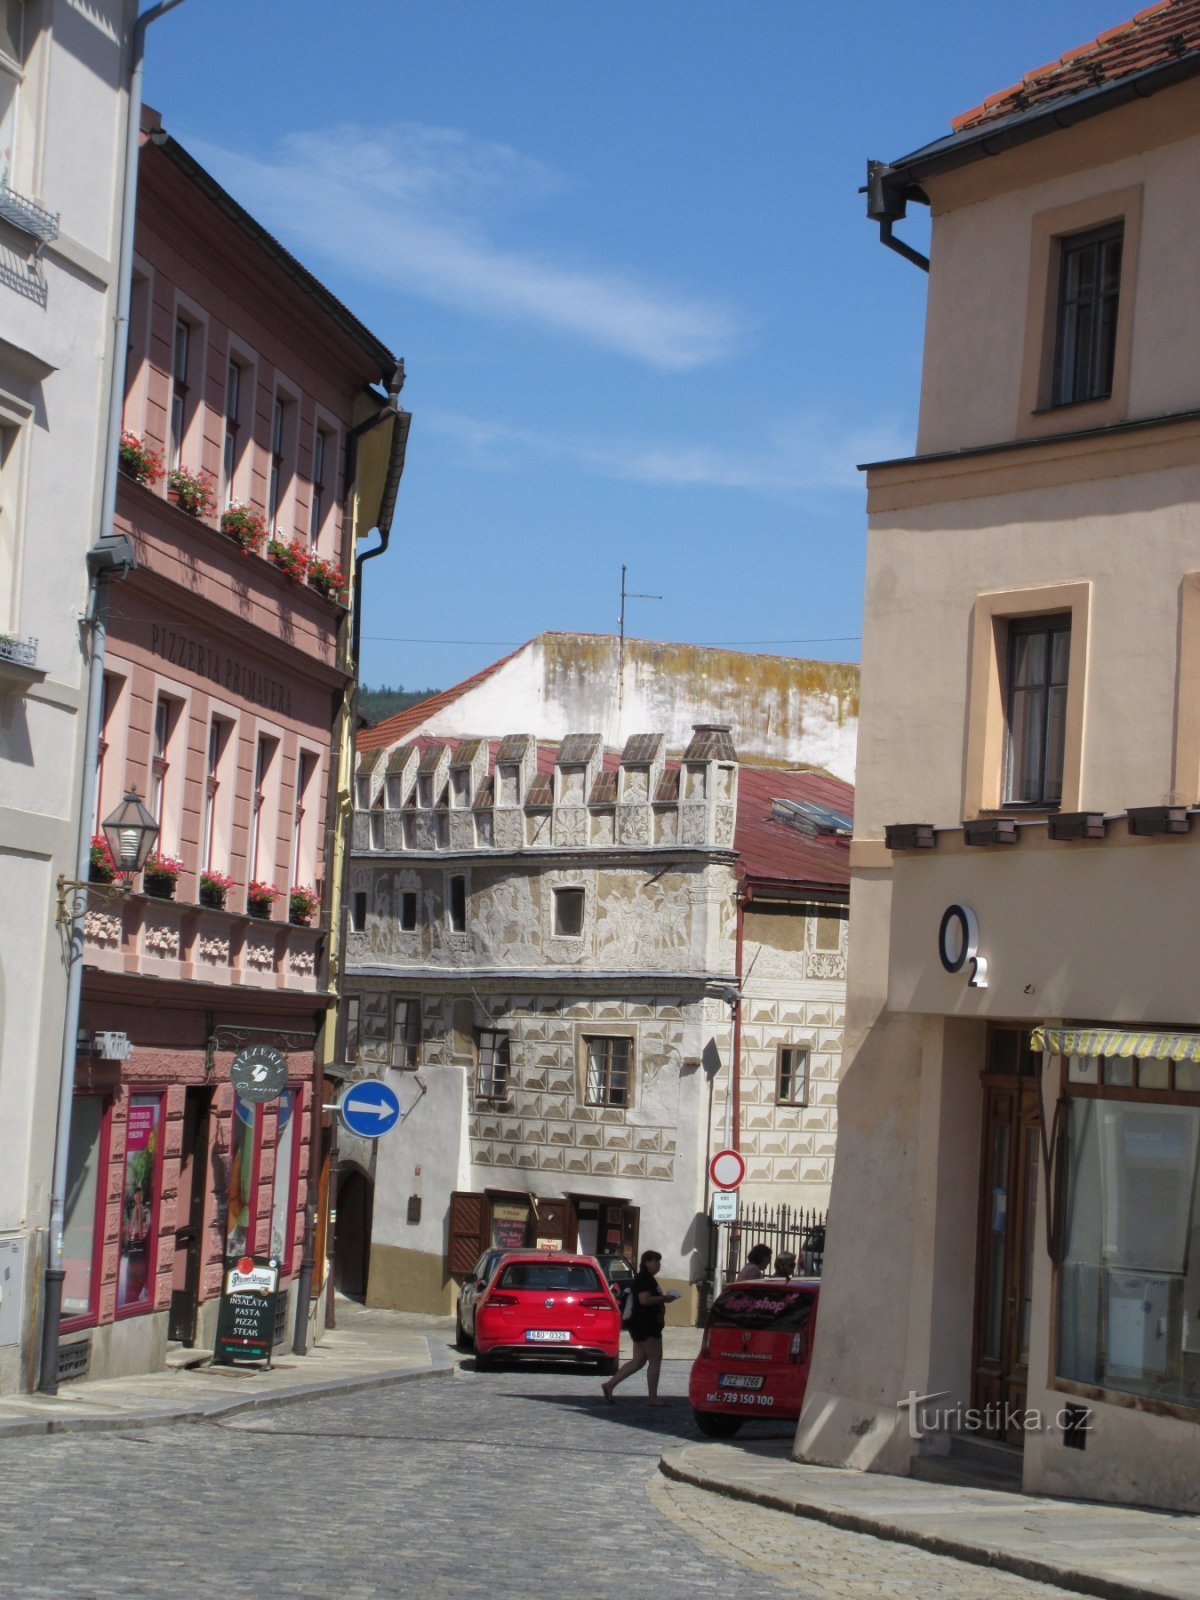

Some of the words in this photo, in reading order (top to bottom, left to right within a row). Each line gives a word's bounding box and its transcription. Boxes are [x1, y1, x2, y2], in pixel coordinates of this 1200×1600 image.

[152, 624, 220, 683] PIZZERIA
[226, 659, 291, 717] PRIMAVERA
[230, 1298, 268, 1308] INSALATA
[235, 1308, 260, 1317] PASTA
[235, 1318, 258, 1327] PIZZA
[233, 1327, 258, 1336] STEAK
[706, 1392, 721, 1402] tel.:
[723, 1392, 738, 1403] 739
[740, 1394, 755, 1404] 150
[756, 1395, 774, 1406] 100
